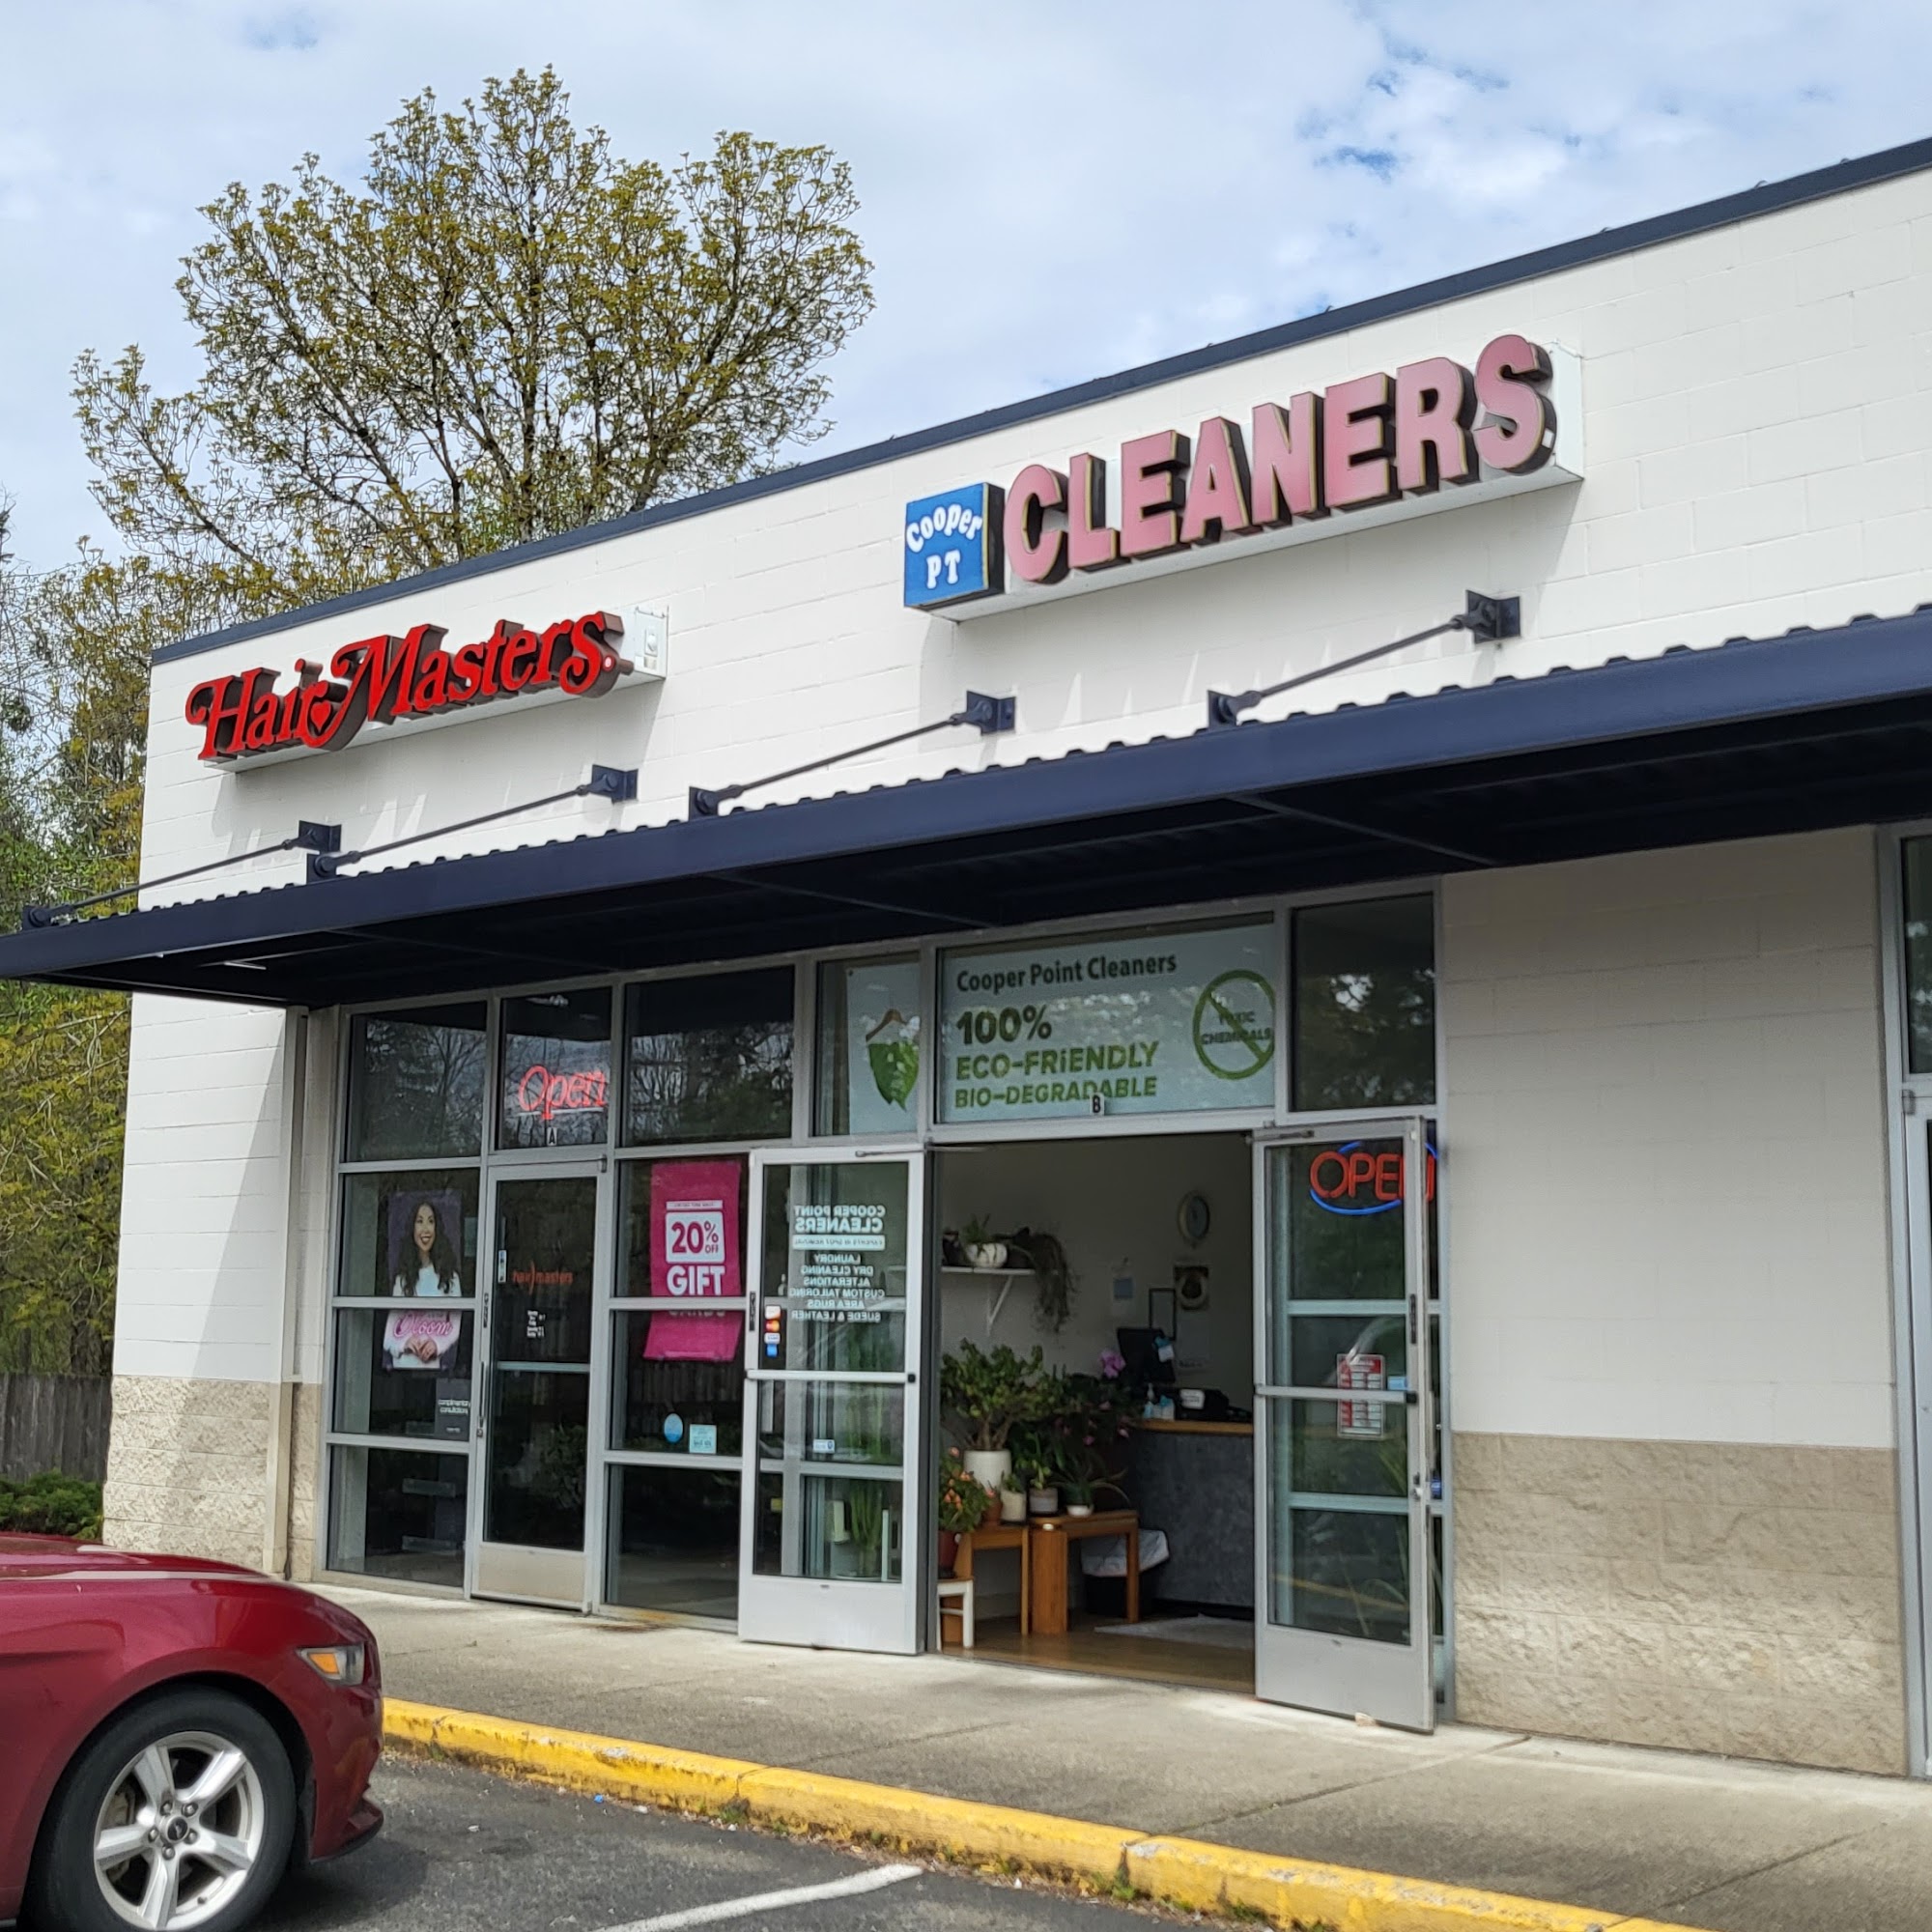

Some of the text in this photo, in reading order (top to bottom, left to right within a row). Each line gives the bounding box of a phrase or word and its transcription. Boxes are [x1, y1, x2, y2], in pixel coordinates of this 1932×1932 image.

[1004, 334, 1555, 584] CLEANERS
[906, 502, 983, 553] Cooper
[925, 548, 961, 589] PT
[956, 953, 1178, 994] Cooper Point Cleaners
[956, 1004, 1053, 1045] 100%
[518, 1065, 607, 1121] Open
[954, 1076, 1158, 1108] BIO-DEGRADABLE
[1092, 1095, 1101, 1113] B
[549, 1131, 556, 1144] A
[670, 1220, 720, 1255] 20%
[704, 1244, 720, 1254] OFF
[667, 1264, 725, 1296] GIFT
